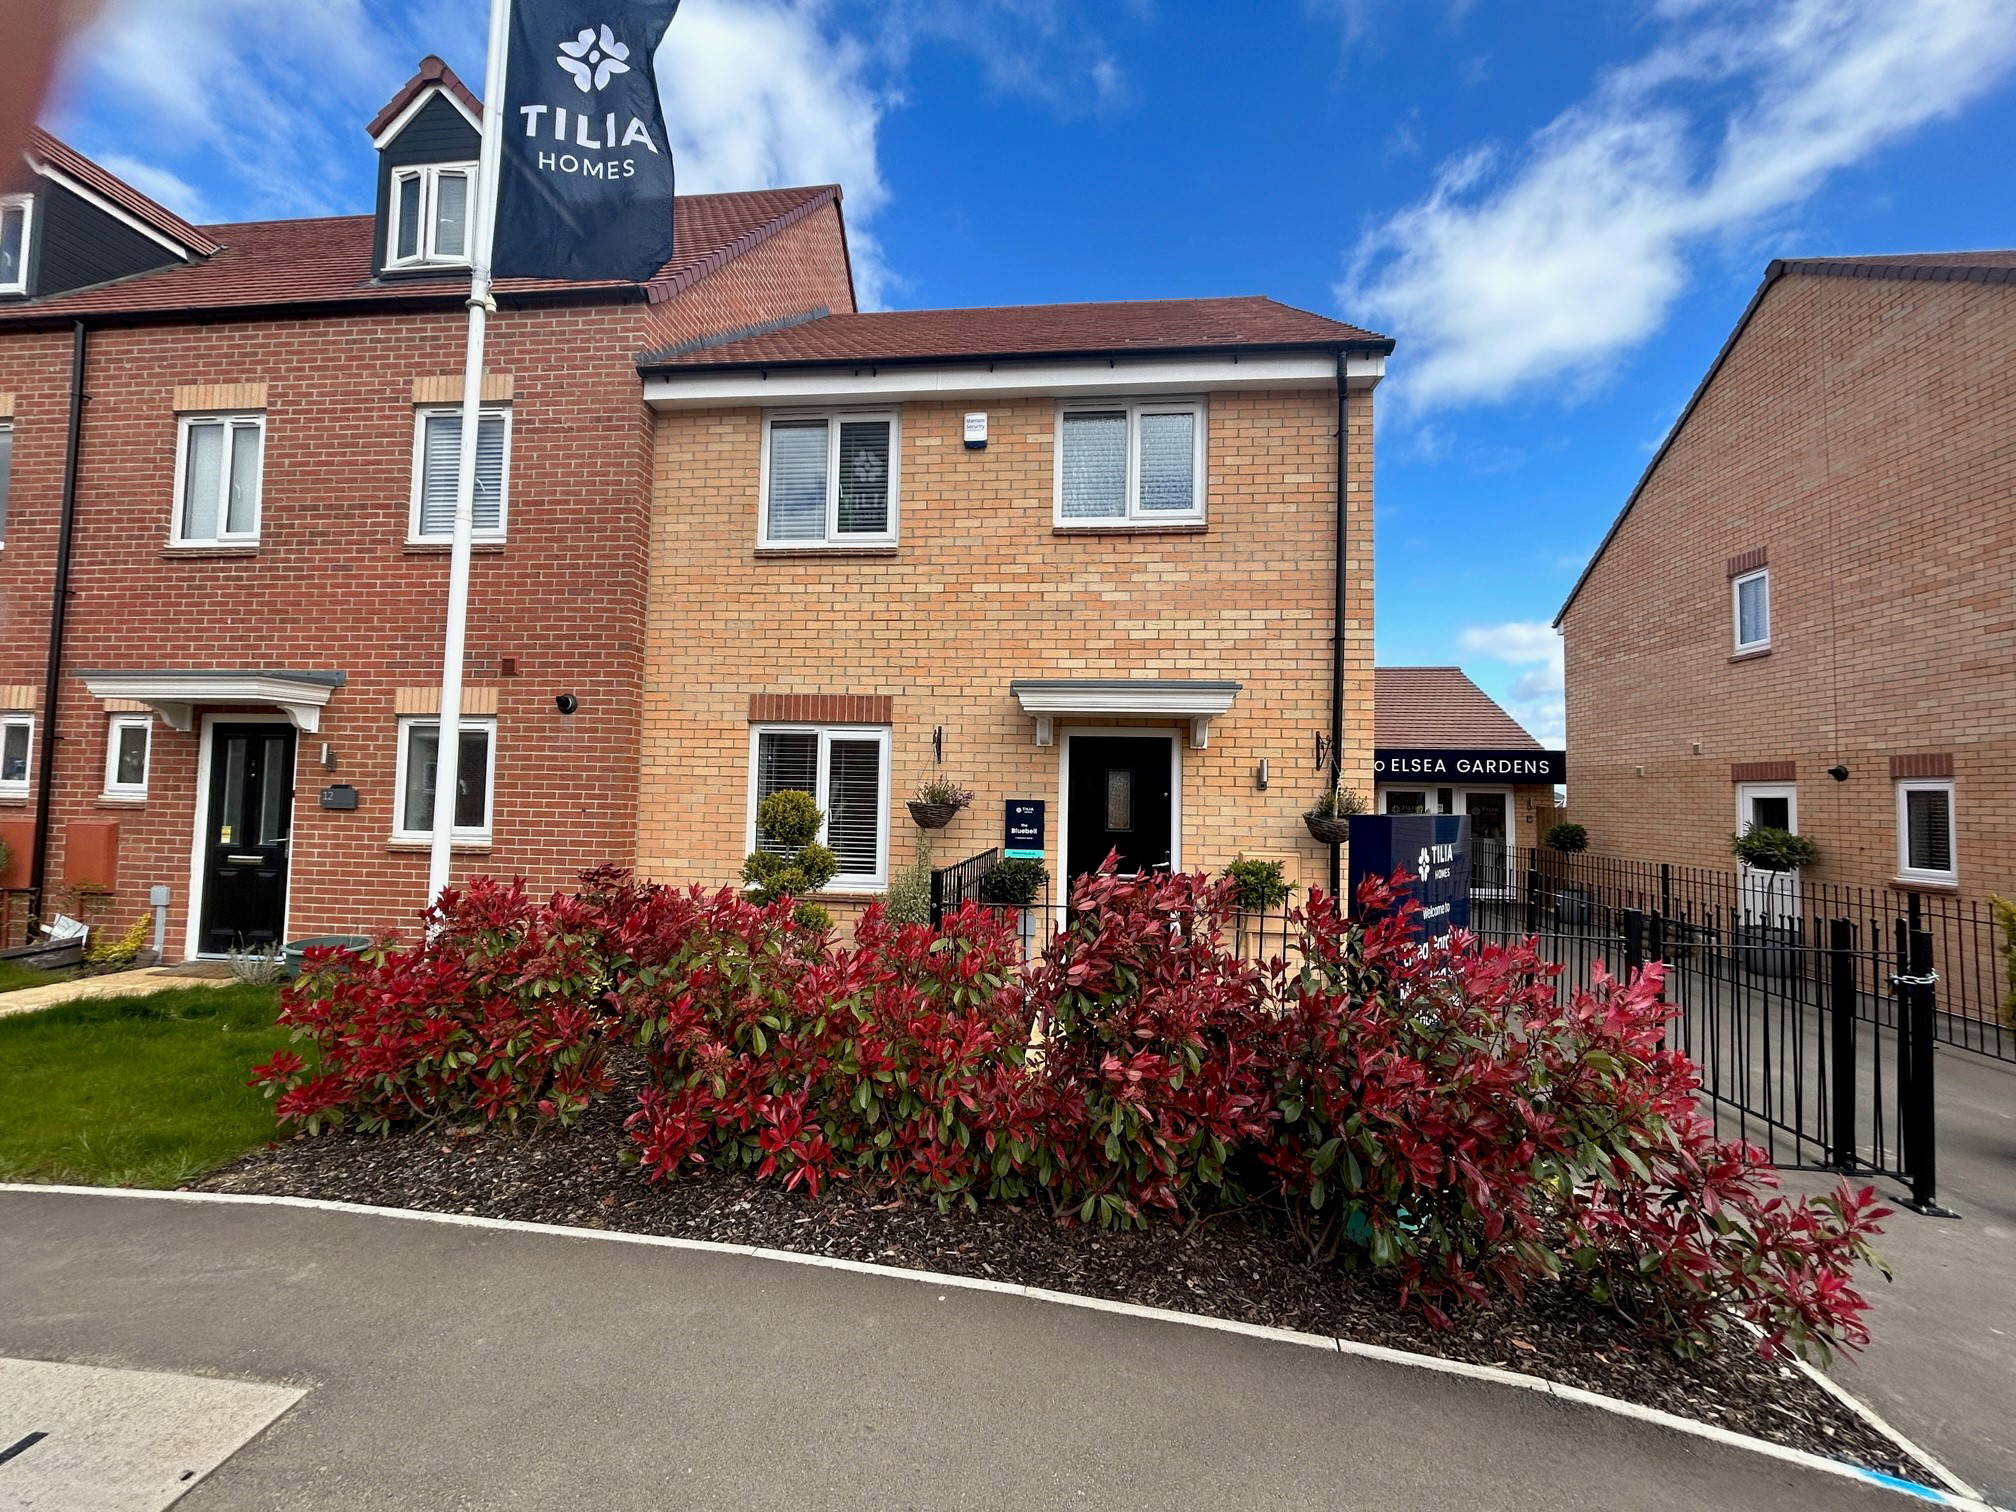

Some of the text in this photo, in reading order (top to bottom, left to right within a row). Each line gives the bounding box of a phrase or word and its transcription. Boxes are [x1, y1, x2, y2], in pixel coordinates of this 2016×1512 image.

[520, 104, 658, 154] TILIA
[538, 151, 635, 180] HOMES
[1391, 758, 1447, 773] ELSEA
[1456, 759, 1550, 774] GARDENS
[322, 791, 334, 801] 12
[1431, 844, 1454, 865] TILIA
[1434, 867, 1451, 880] HOMES
[1422, 903, 1445, 920] Welcome
